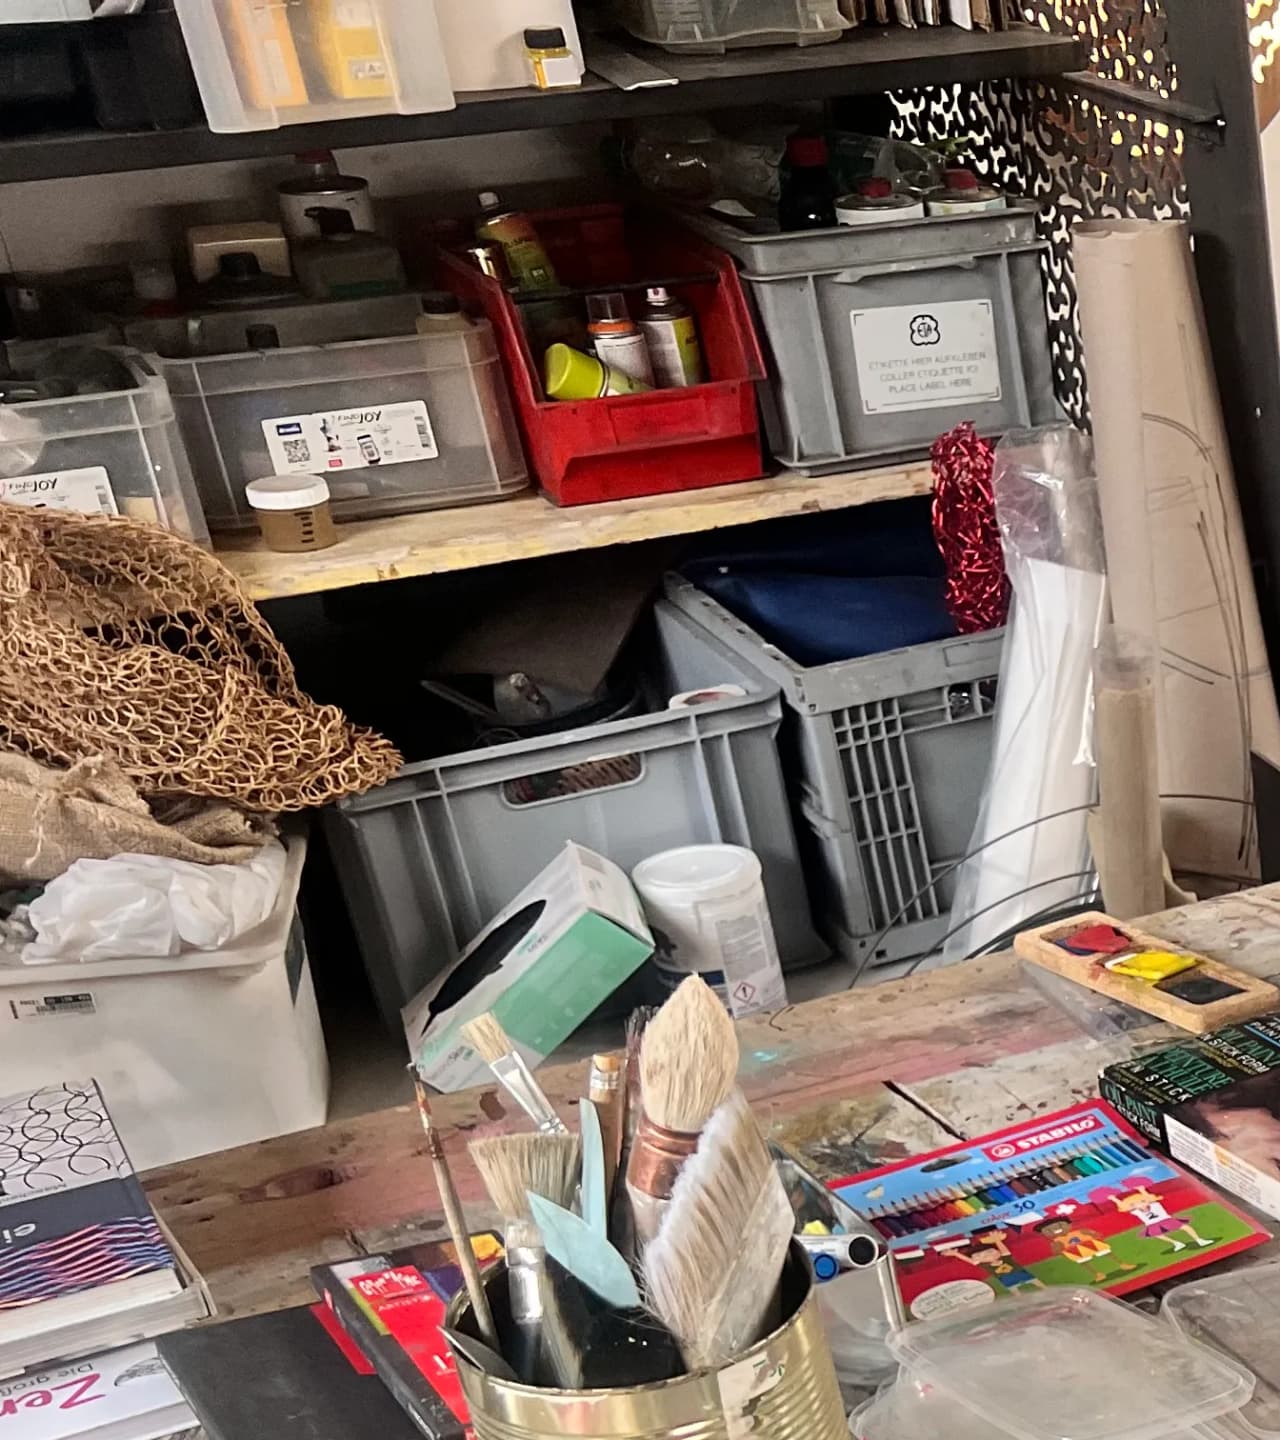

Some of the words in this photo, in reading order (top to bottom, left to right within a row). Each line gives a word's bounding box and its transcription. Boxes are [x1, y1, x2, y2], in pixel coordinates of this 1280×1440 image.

[869, 357, 909, 370] ETIKETTE
[911, 357, 933, 367] HIER
[935, 351, 987, 364] AUFKLEBEN
[880, 370, 915, 383] COLLER
[917, 366, 963, 377] ETIQUETTE
[889, 383, 917, 393] PLACE
[920, 380, 946, 391] LABEL
[1209, 1038, 1239, 1058] STICK
[1237, 1054, 1270, 1073] FORM
[1145, 1073, 1193, 1102] STICK
[1017, 1119, 1095, 1148] STABILO
[58, 1363, 93, 1377] Die
